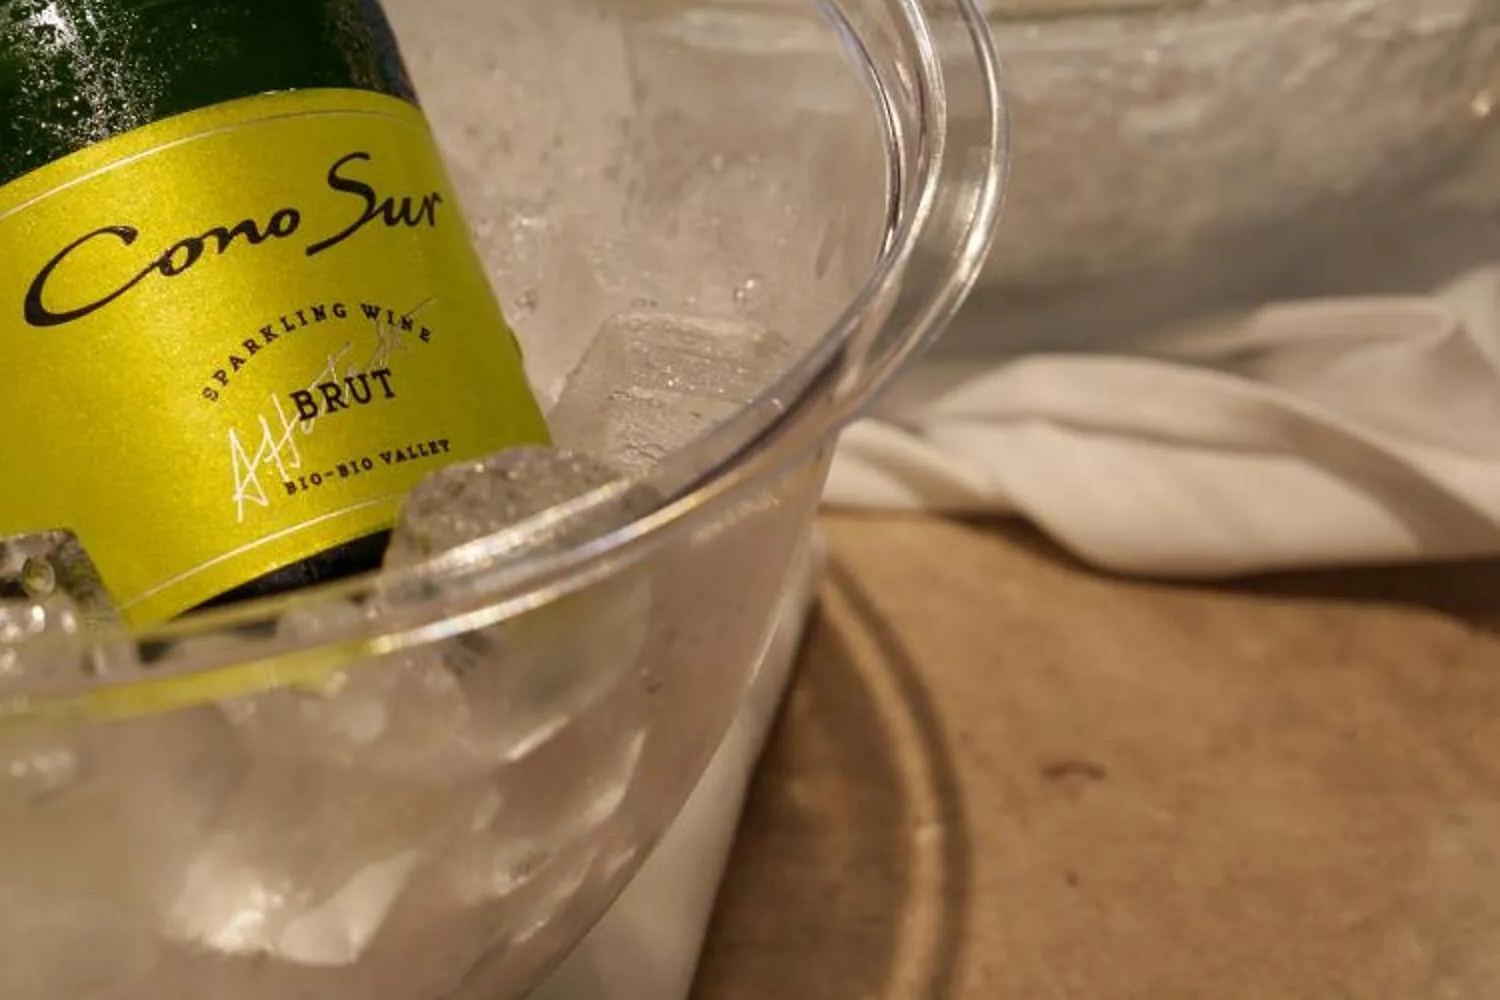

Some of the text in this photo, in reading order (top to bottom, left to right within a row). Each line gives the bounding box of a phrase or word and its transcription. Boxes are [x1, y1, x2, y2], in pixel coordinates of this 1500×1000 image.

[23, 151, 444, 328] Cono Sur
[202, 303, 433, 402] SPARKLING WINE
[289, 367, 395, 421] BRUT
[284, 438, 451, 495] BIO-BIO VALLEY
